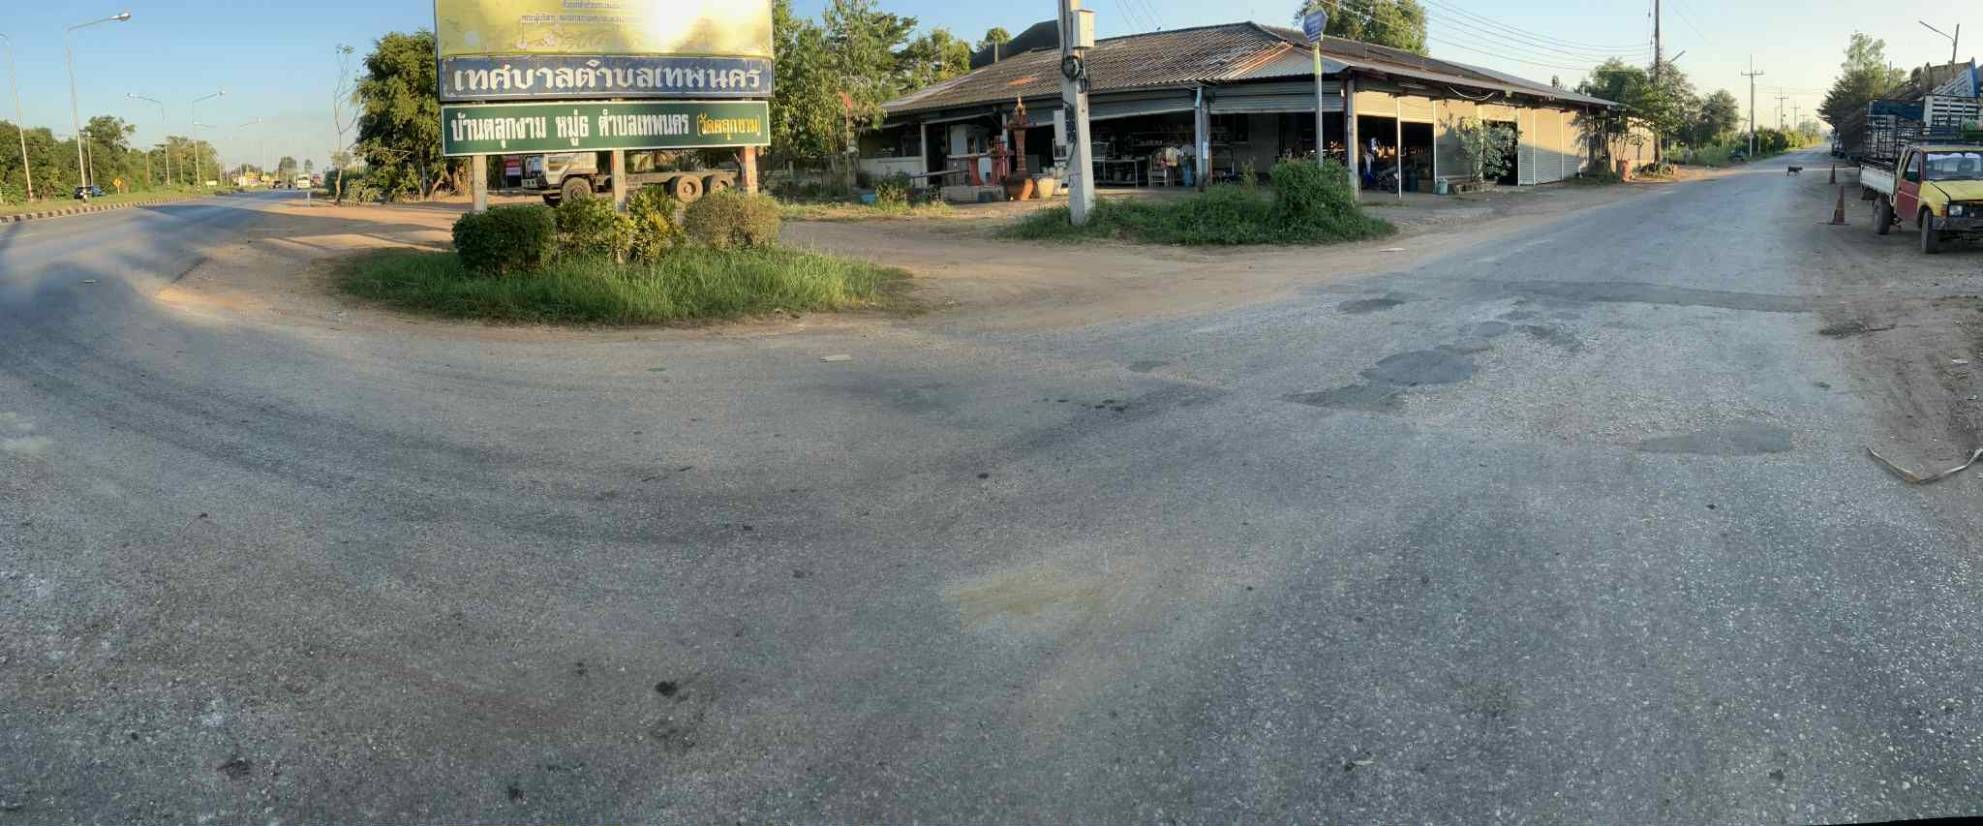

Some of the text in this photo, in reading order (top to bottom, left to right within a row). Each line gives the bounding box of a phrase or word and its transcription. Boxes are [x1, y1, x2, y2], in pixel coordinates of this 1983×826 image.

[454, 59, 761, 91] เทศบาลตำบลเทพนคร
[598, 108, 689, 137] ตำบลเทพนคร
